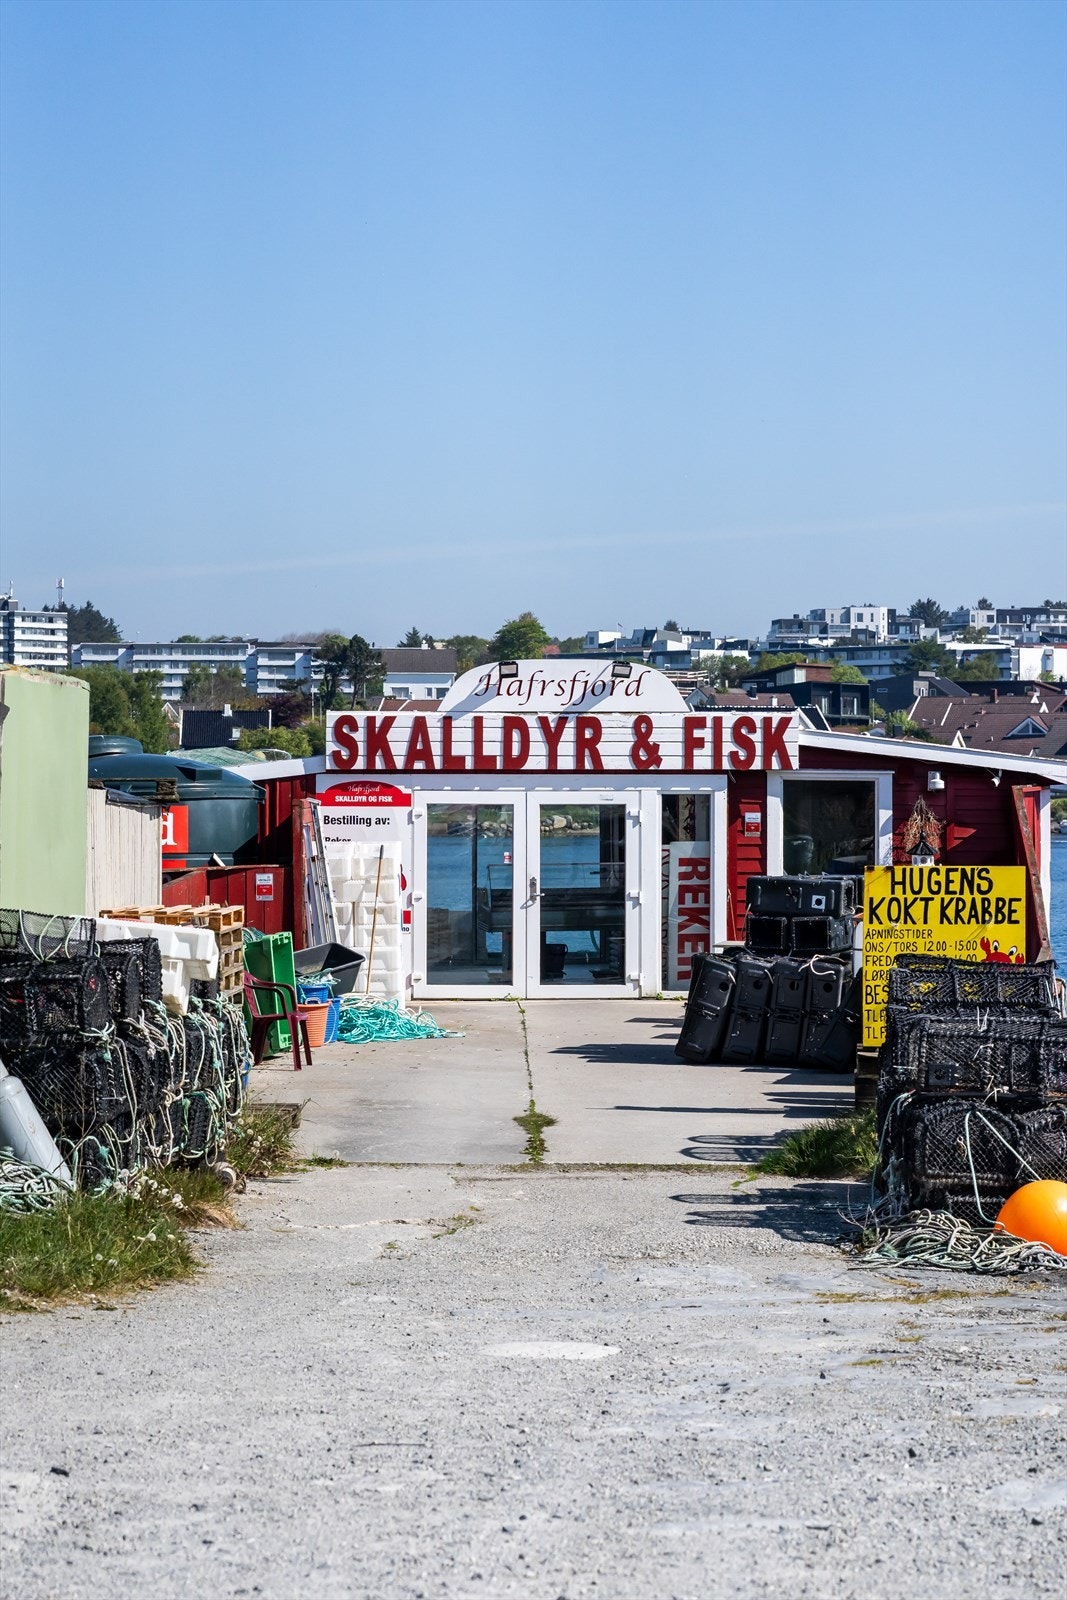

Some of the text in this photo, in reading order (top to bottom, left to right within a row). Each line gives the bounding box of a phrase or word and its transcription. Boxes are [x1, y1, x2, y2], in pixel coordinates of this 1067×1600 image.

[475, 670, 650, 706] Hafrsfjord
[332, 715, 793, 770] SKALLDYR & FISK
[335, 795, 393, 803] SKALLDYR OG FISK
[323, 815, 390, 827] Bestilling av:
[868, 896, 1022, 925] KOKT KRABBE
